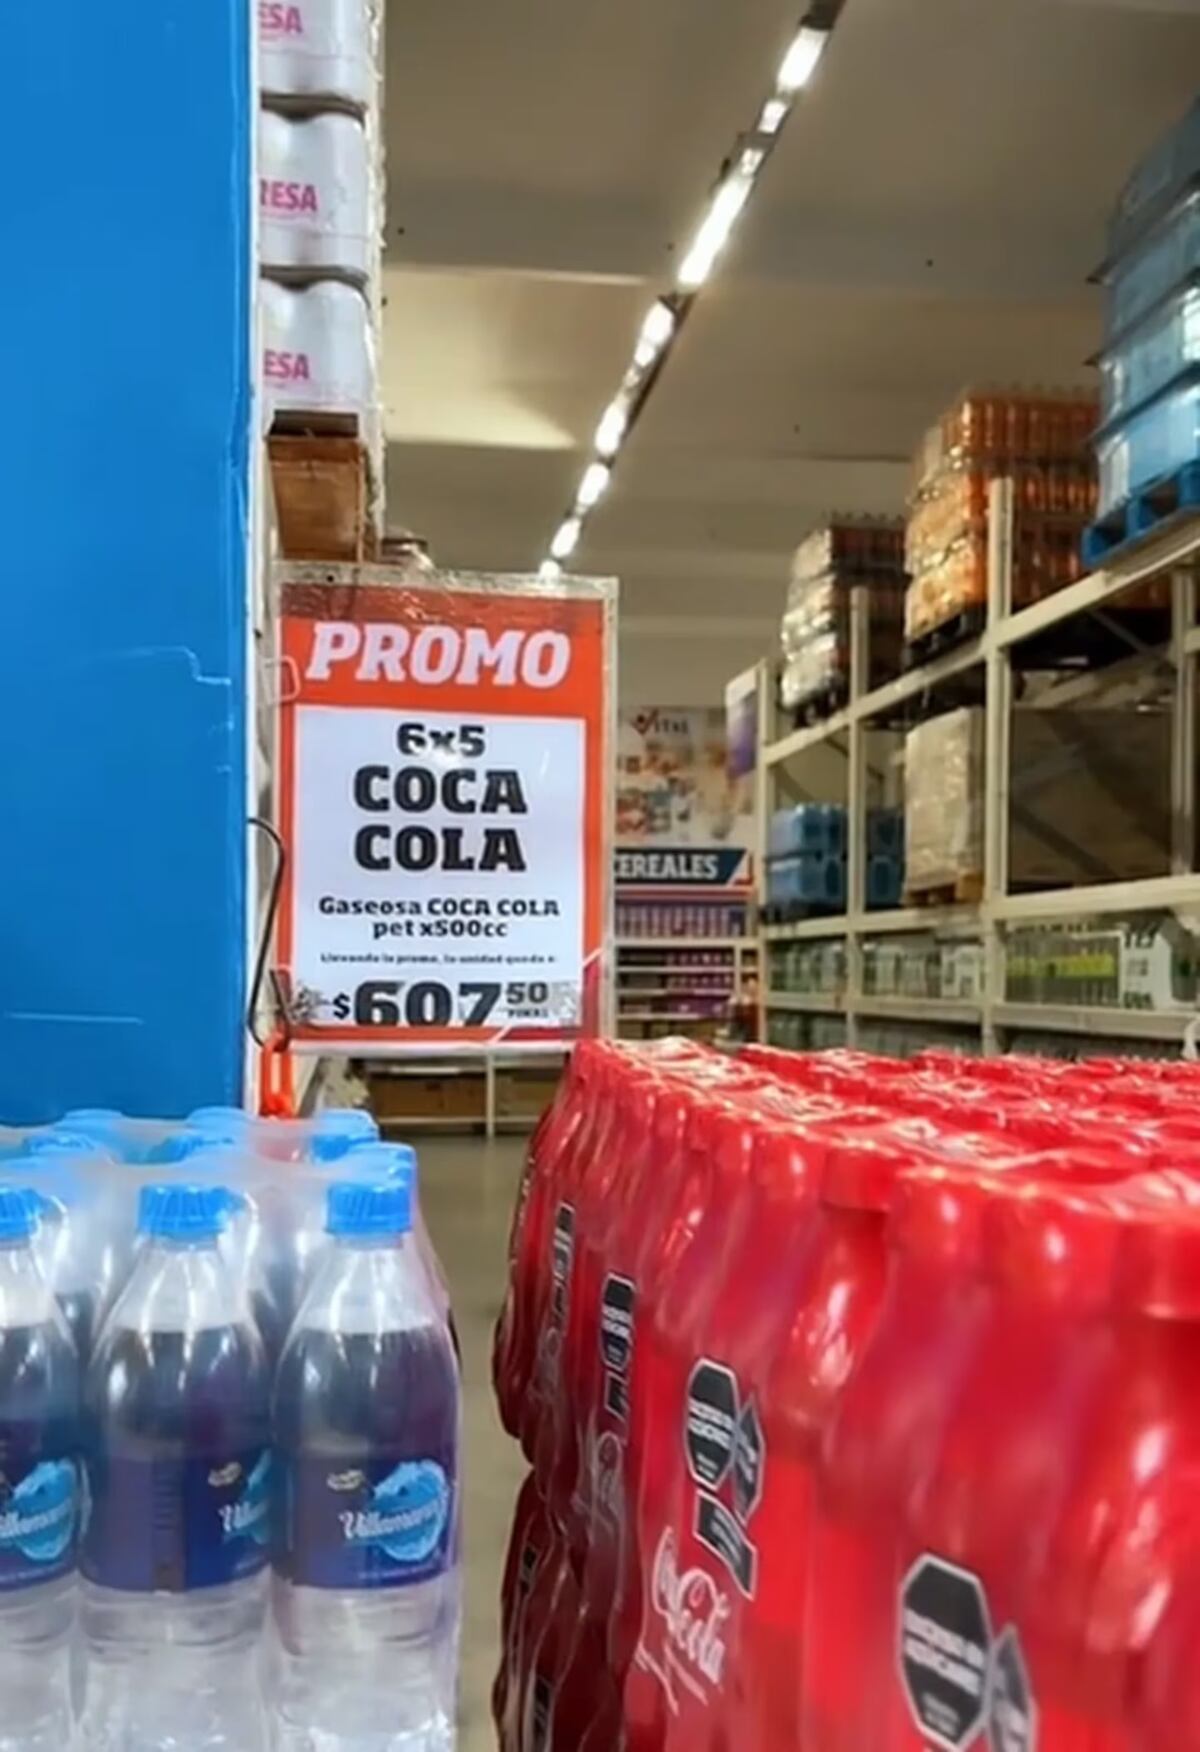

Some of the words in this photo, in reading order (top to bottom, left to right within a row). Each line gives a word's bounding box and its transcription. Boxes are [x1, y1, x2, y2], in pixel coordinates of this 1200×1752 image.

[305, 621, 571, 688] PROMO
[397, 723, 485, 757] 6x5
[353, 765, 528, 814] COCA
[354, 824, 527, 872] COLA
[319, 896, 422, 915] Gaseosa
[427, 898, 491, 916] COCA
[496, 899, 560, 917] COLA
[373, 919, 415, 940] pet
[419, 920, 508, 938] x500cc
[506, 981, 549, 1005] 50
